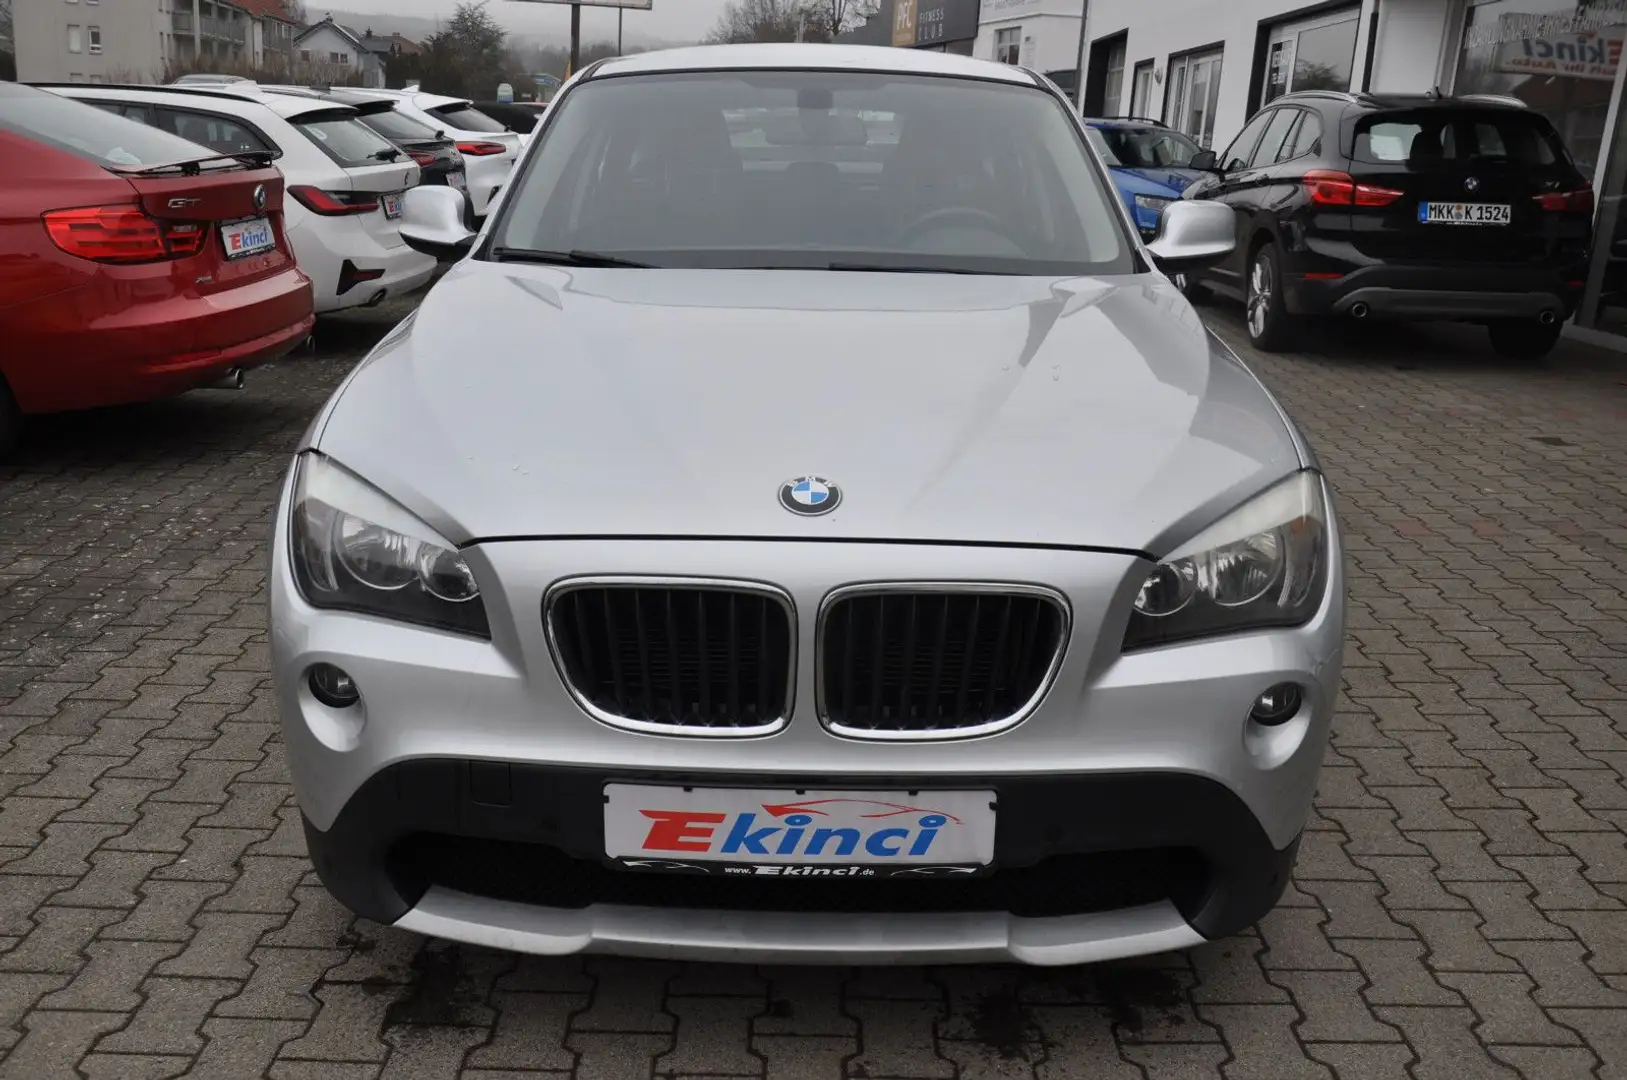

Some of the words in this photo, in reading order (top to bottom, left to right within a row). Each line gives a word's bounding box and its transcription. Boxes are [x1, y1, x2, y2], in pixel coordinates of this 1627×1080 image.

[1428, 204, 1455, 220] MKK
[1464, 206, 1473, 221] K
[1476, 206, 1510, 221] 1524
[228, 226, 268, 250] Ekinci
[638, 809, 947, 856] Ekinci
[724, 865, 875, 876] www.Ekinci.de
